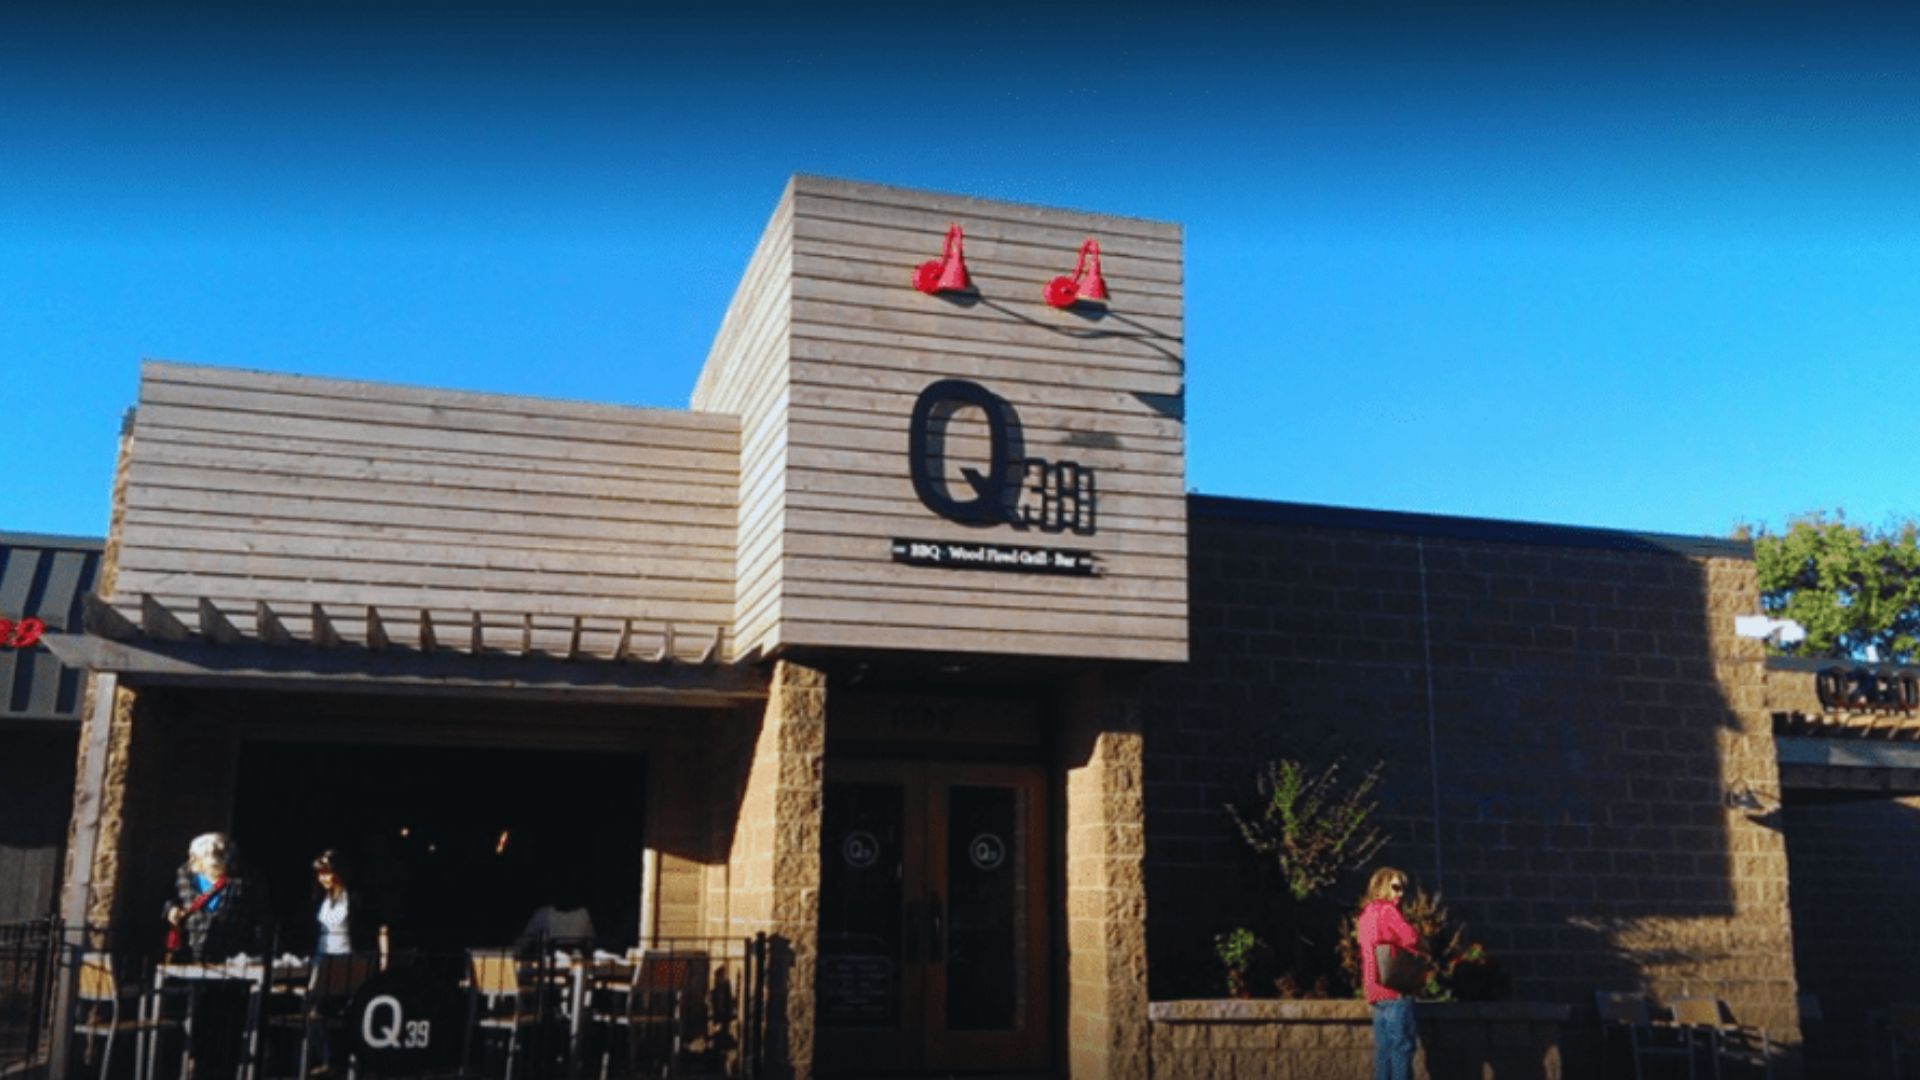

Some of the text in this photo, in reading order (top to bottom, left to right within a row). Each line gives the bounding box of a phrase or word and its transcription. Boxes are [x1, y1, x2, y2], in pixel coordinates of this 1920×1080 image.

[910, 543, 940, 561] BBQ
[948, 547, 985, 562] Wood
[1054, 552, 1077, 568] Bar
